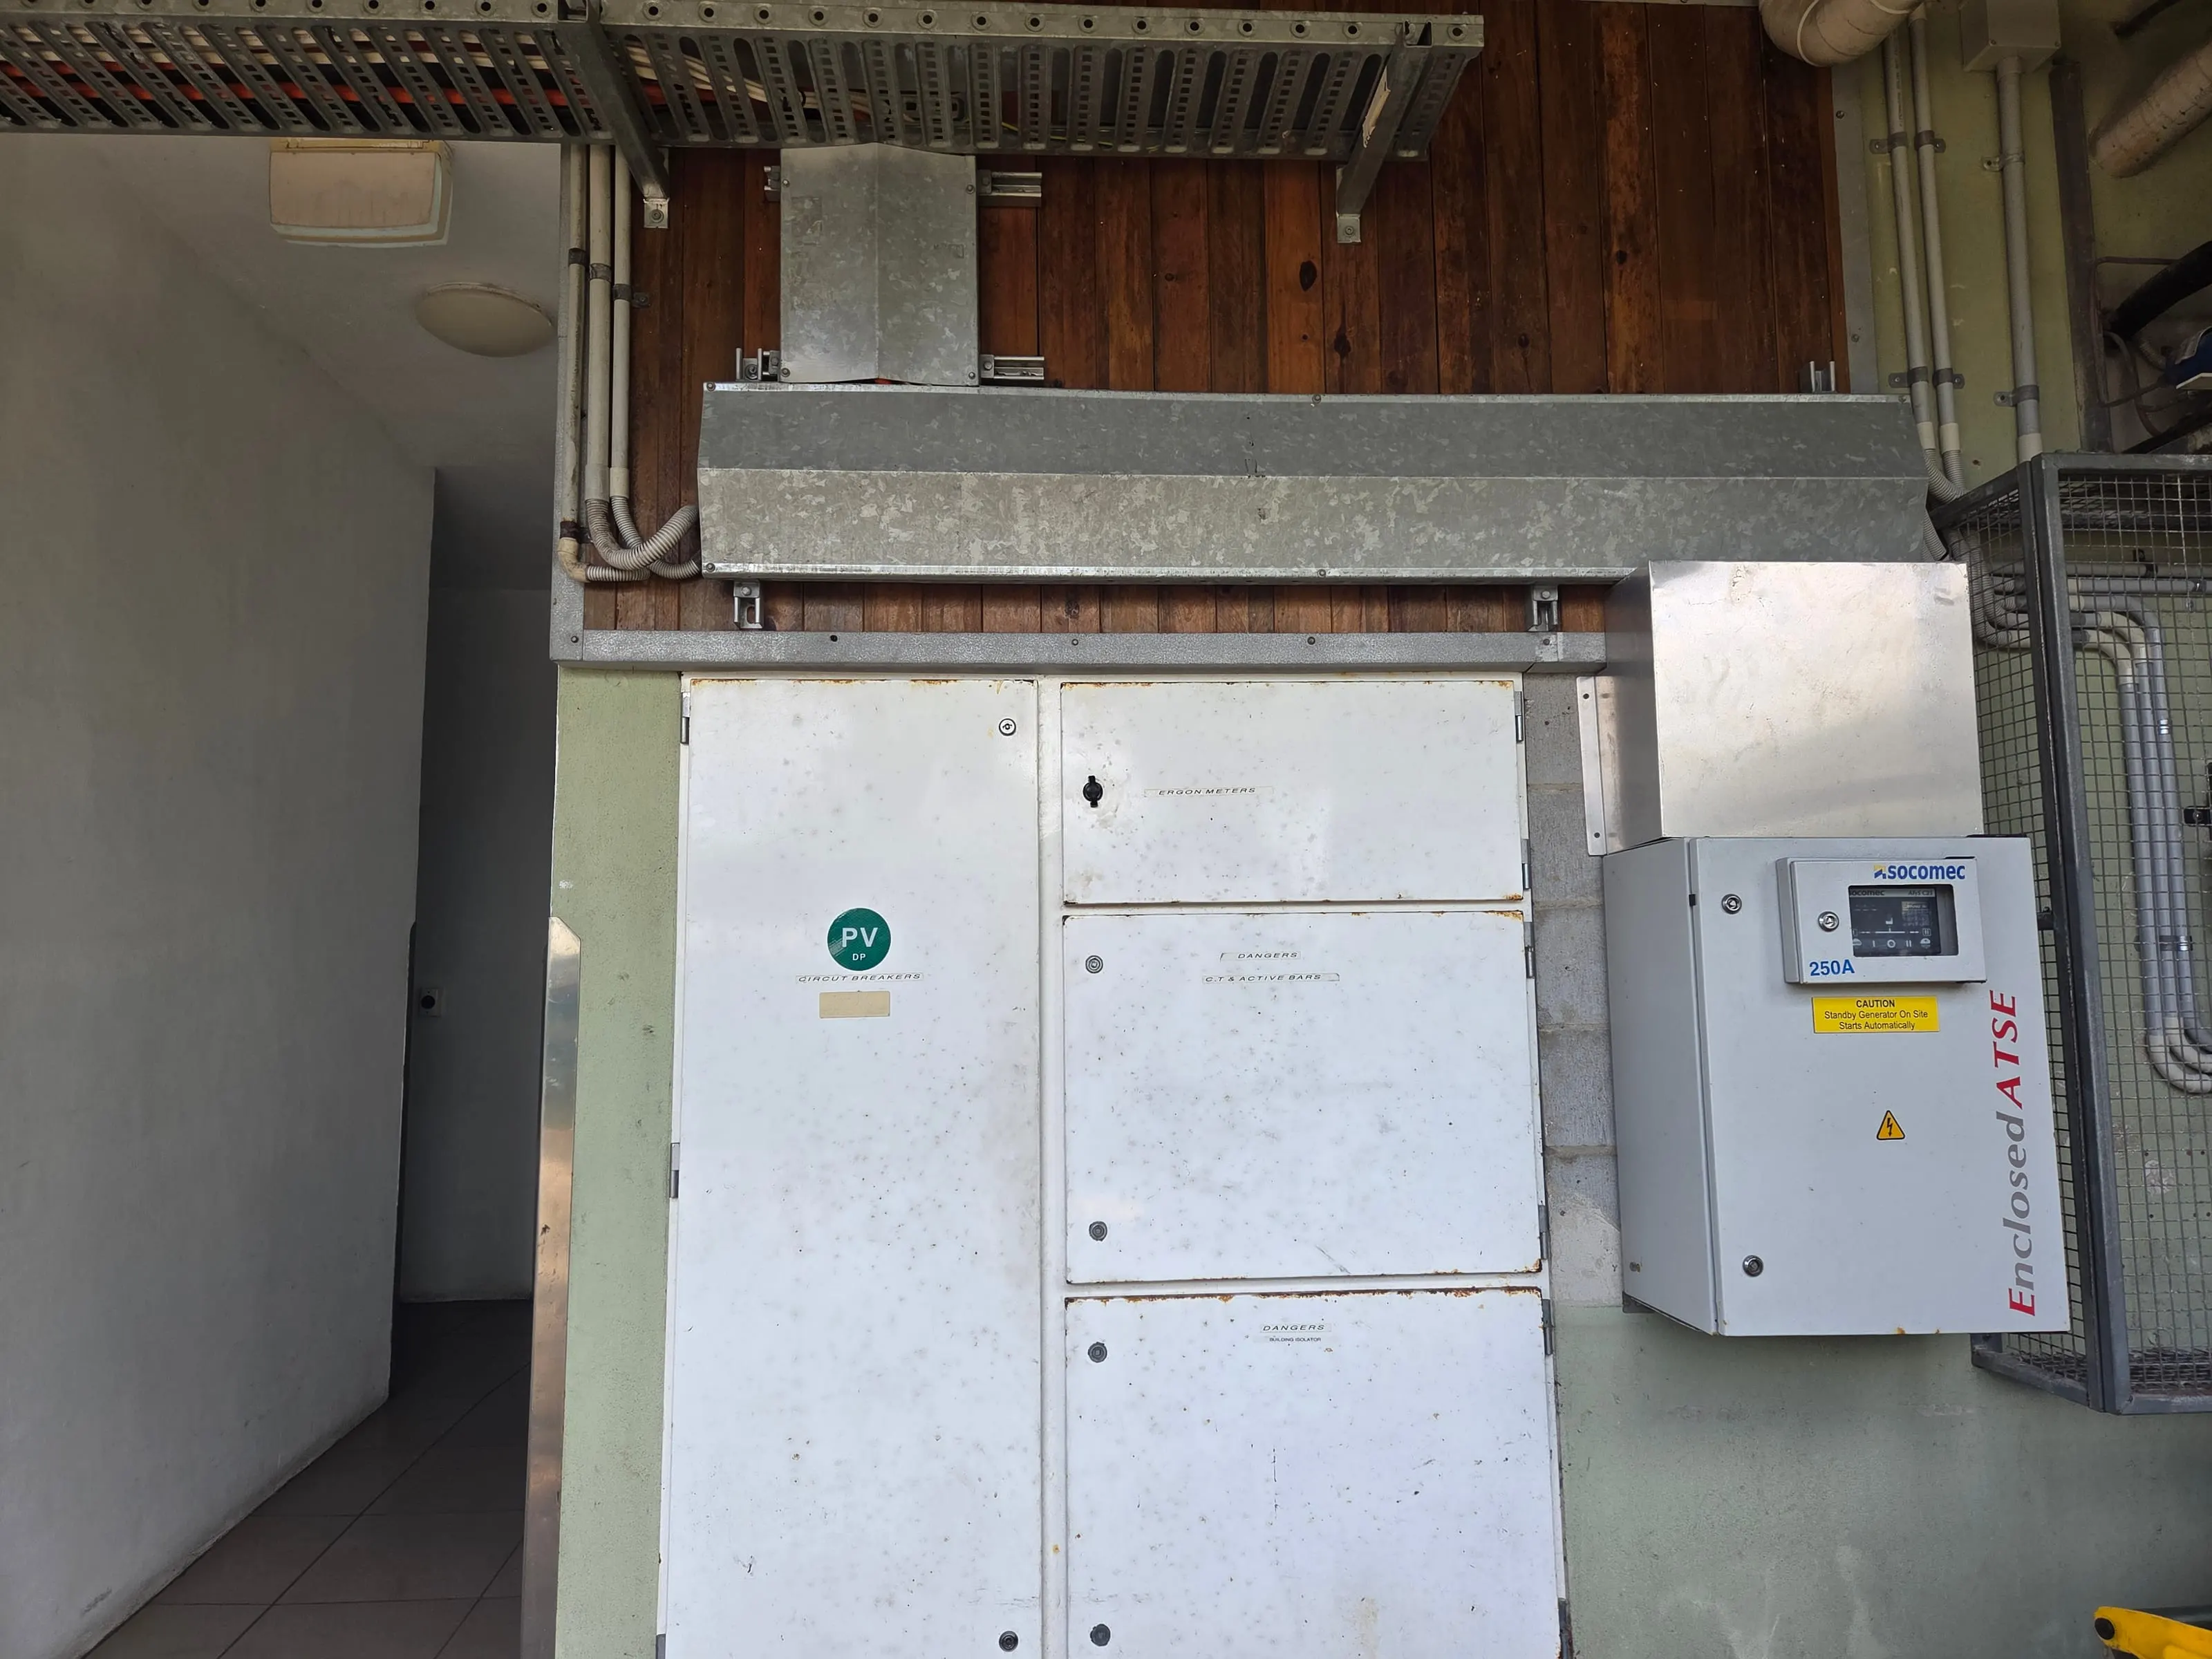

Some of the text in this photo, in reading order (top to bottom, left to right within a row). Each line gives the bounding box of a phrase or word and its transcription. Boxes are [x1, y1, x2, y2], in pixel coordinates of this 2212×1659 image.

[1888, 865, 1966, 880] socomec
[841, 927, 879, 948] PV
[1808, 959, 1855, 977] 250A
[851, 973, 921, 982] BREAKERS
[1856, 1000, 1895, 1008] CAUTION
[1824, 1011, 1857, 1020] Standby
[1859, 1011, 1897, 1019] Generator
[1913, 1010, 1929, 1018] Site
[1839, 1022, 1915, 1030] Starts Automatically
[1989, 989, 2036, 1317] Enclosed ATSE
